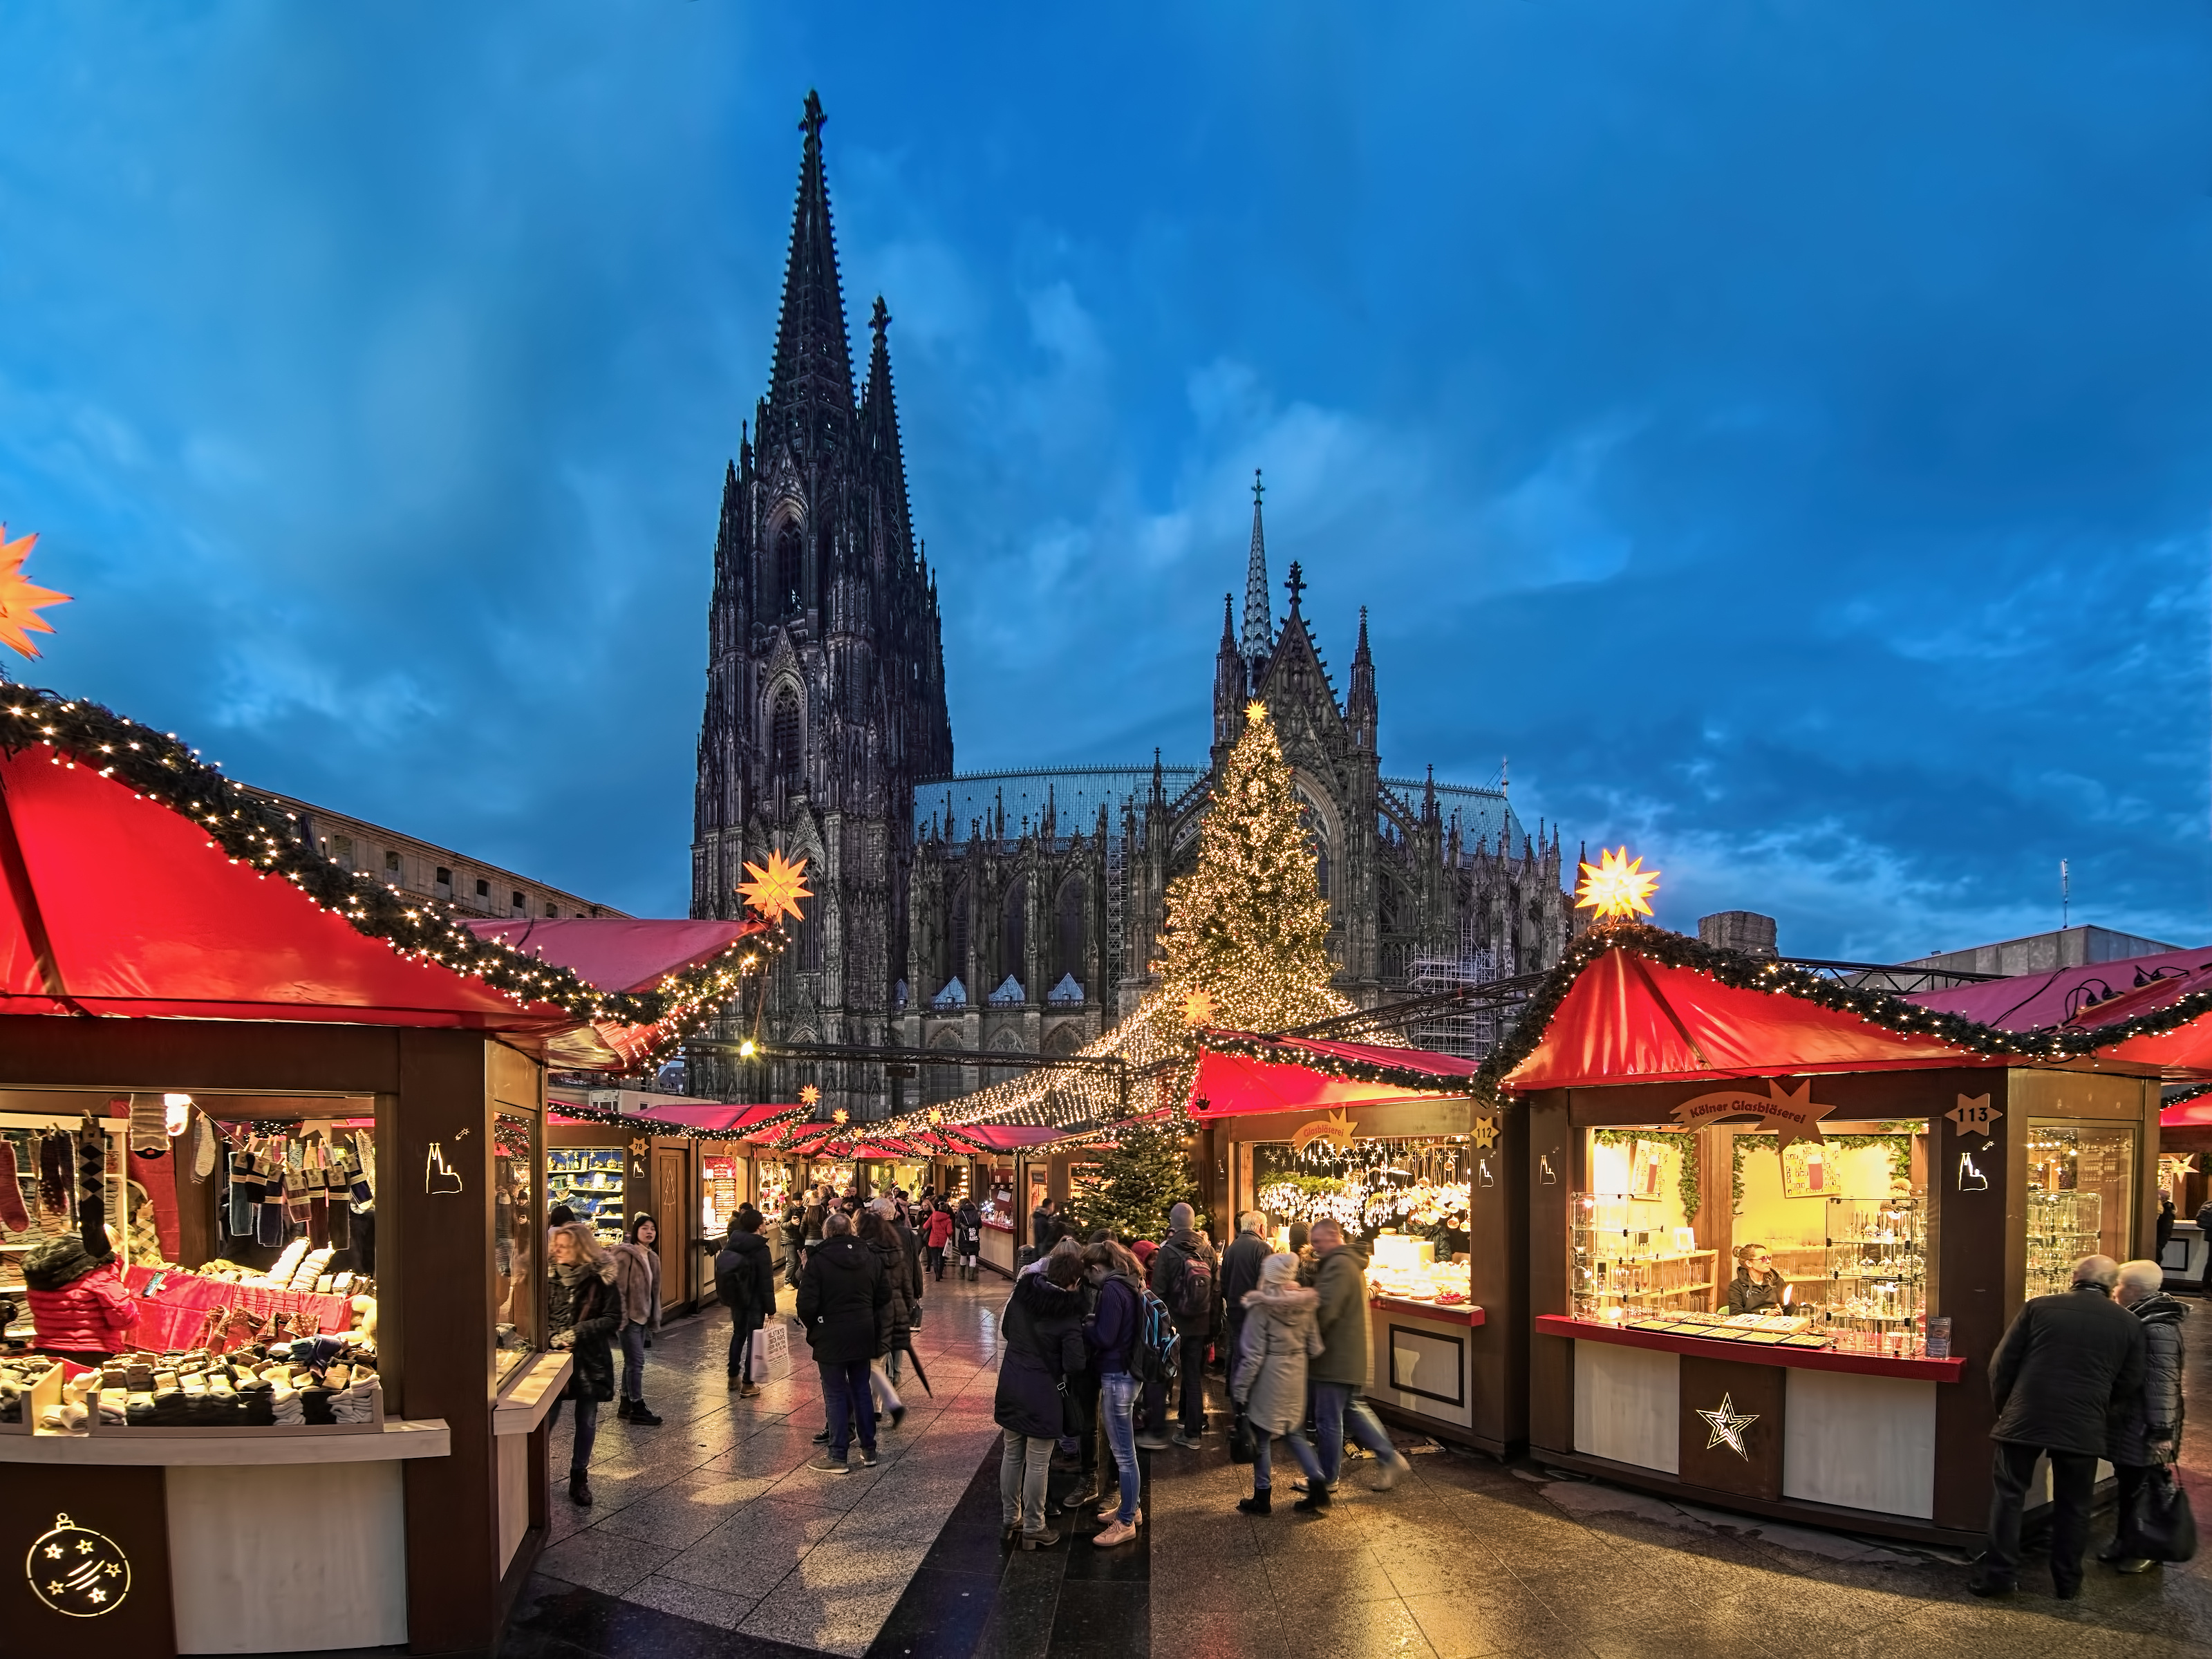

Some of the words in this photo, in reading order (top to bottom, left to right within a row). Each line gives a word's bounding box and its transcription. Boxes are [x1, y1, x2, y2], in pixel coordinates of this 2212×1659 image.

[1689, 1103, 1728, 1118] Kölner
[1731, 1100, 1806, 1124] Glasbläserei
[1958, 1107, 1988, 1122] 113
[1303, 1124, 1344, 1137] Glasbläserei
[1477, 1127, 1492, 1138] 112
